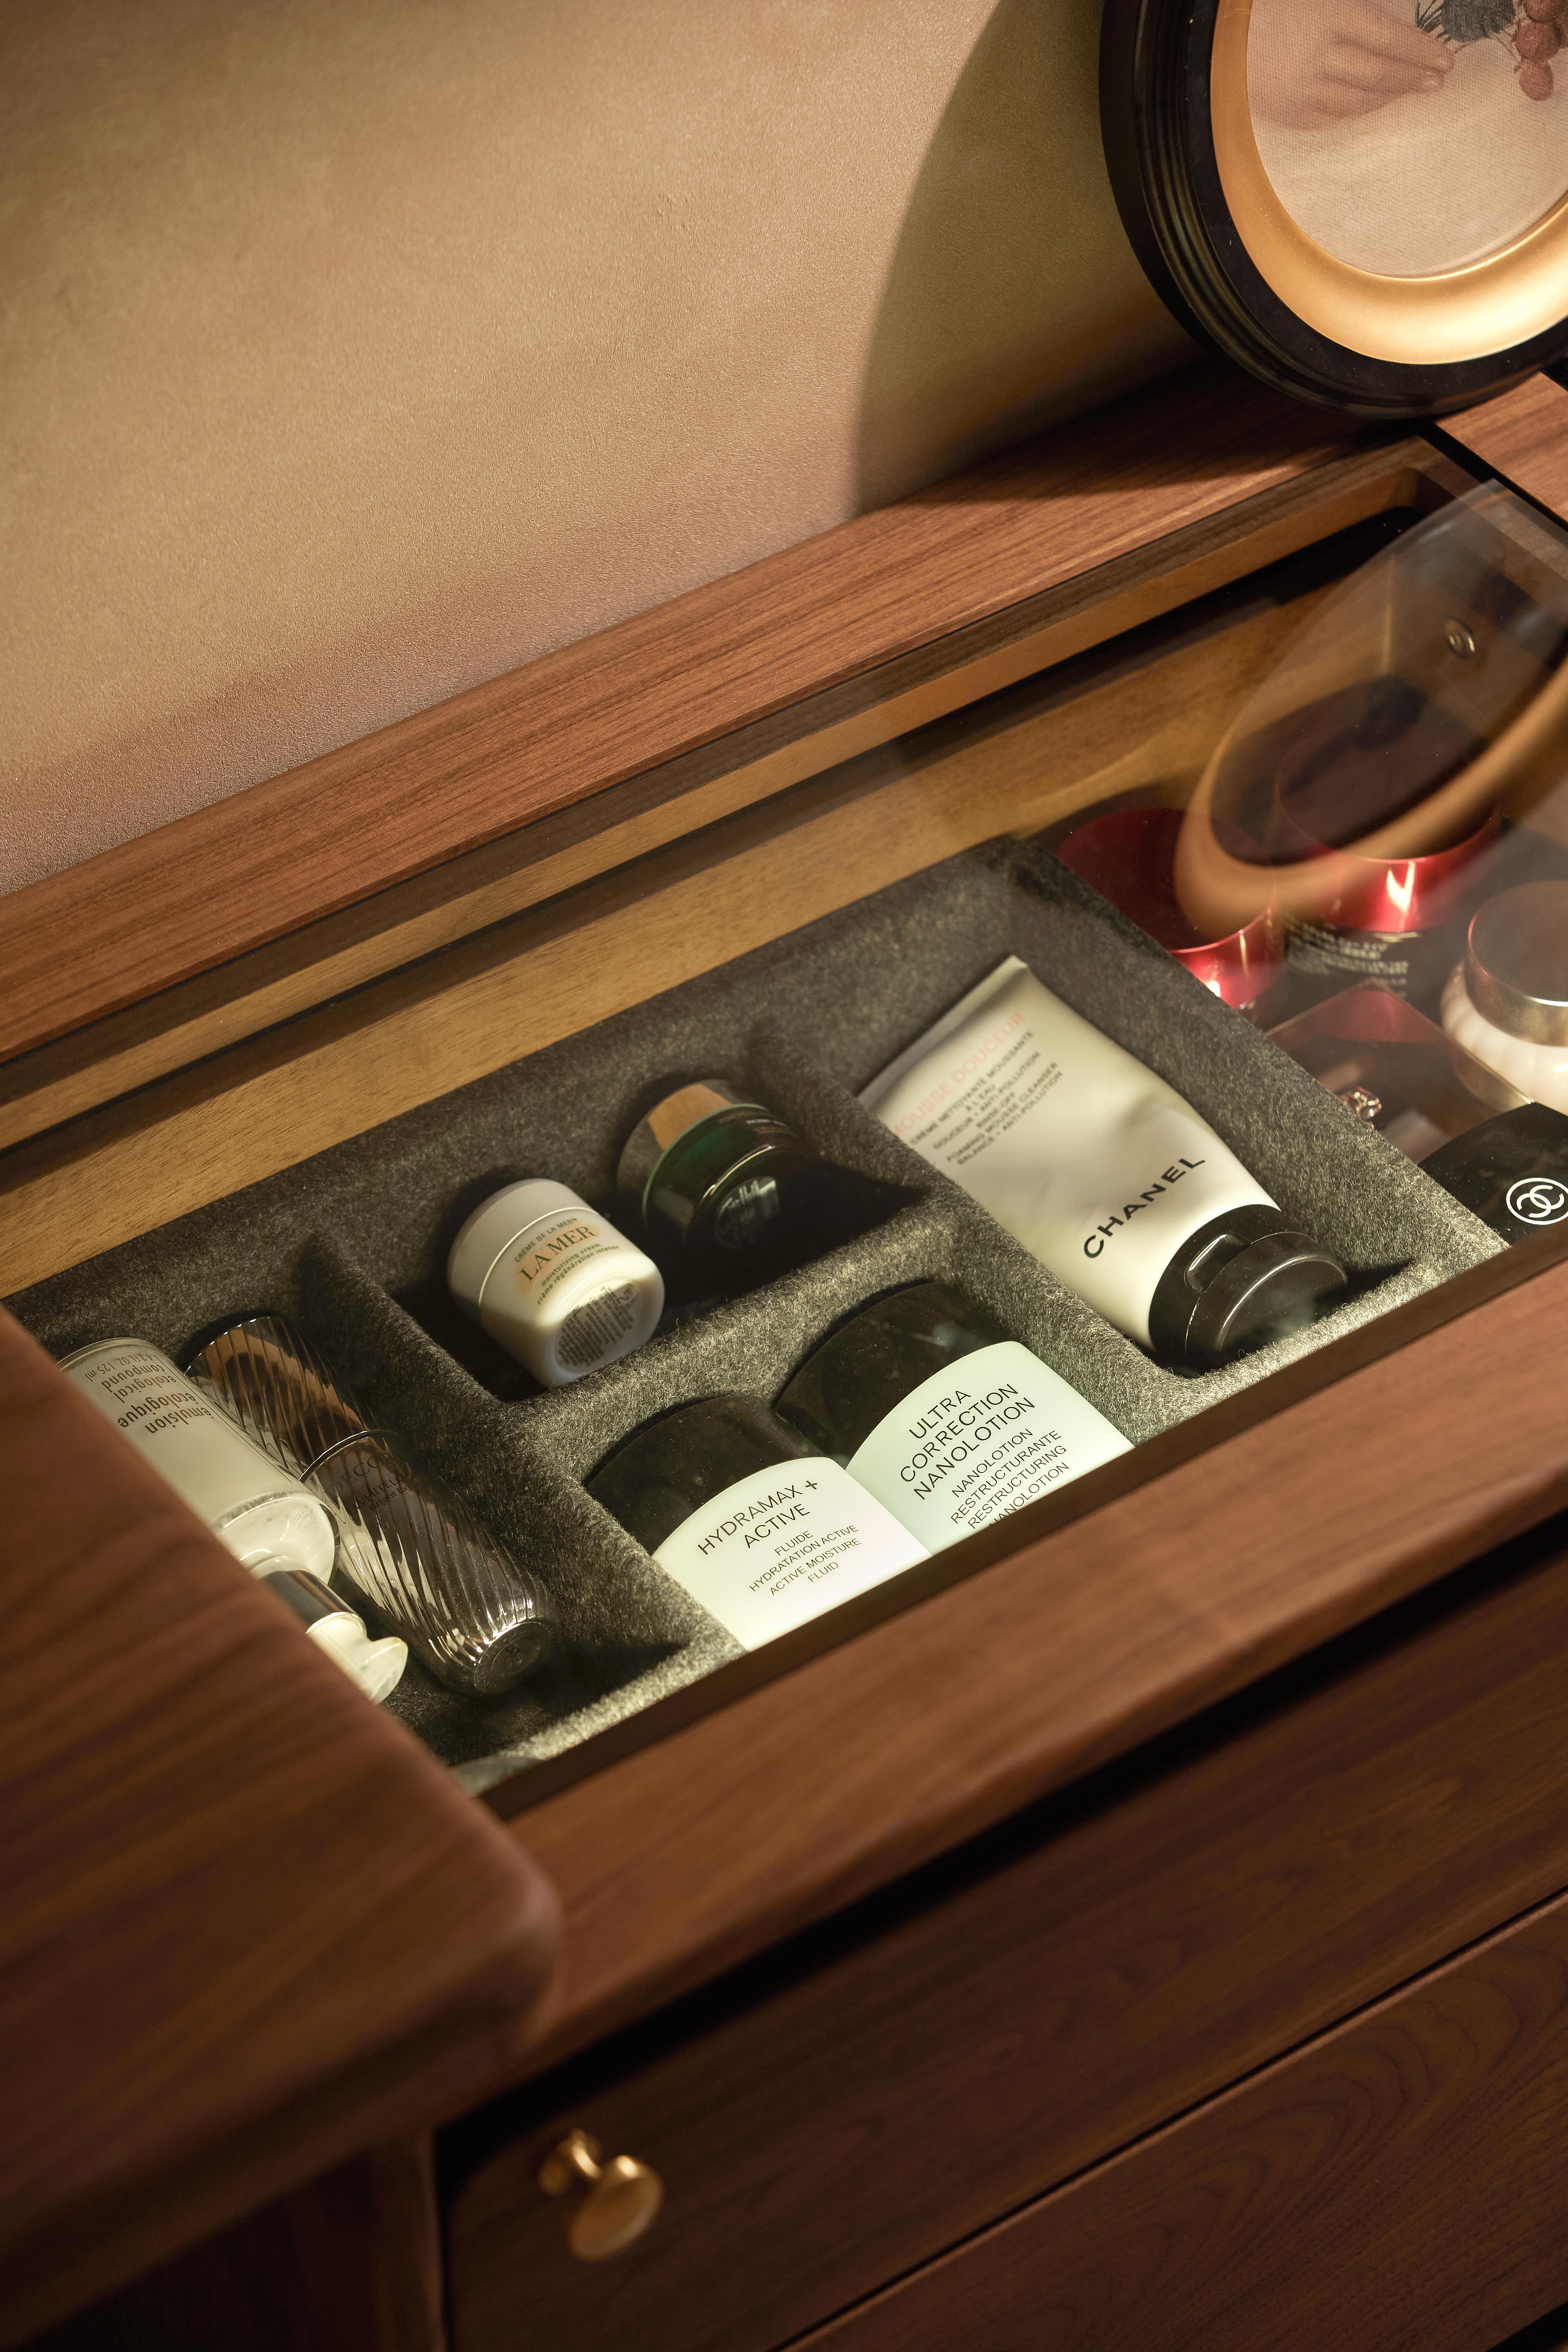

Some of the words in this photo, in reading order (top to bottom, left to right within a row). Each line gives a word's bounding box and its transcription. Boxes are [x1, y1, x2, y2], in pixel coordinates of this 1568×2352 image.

[1084, 1158, 1205, 1258] CHANEL
[519, 1255, 551, 1283] LA
[546, 1227, 596, 1255] MER
[536, 1233, 546, 1241] DE
[537, 1283, 553, 1305] crème
[554, 1252, 594, 1283] régénération
[596, 1246, 619, 1254] intense
[541, 1253, 580, 1287] moisturizing
[580, 1243, 601, 1254] cream
[85, 1370, 97, 1382] ml
[97, 1362, 116, 1374] 125
[101, 1365, 164, 1393] compound
[113, 1376, 176, 1403] ecological
[117, 1393, 198, 1427] écologique
[145, 1407, 214, 1433] émulsion
[900, 1384, 1018, 1482] CORRECTION
[909, 1390, 971, 1439] ULTRA
[913, 1397, 1035, 1500] NANOLOTION
[952, 1429, 1033, 1497] NANOLOTION
[950, 1430, 1061, 1524] RESTRUCTURANTE
[968, 1445, 1067, 1529] RESTRUCTURING
[989, 1462, 1069, 1525] ANOLOTION
[698, 1485, 803, 1555] HYDRAMAX
[805, 1481, 818, 1489] +
[744, 1504, 810, 1548] ACTIVE
[775, 1531, 814, 1556] FLUIDE
[750, 1541, 821, 1592] HYDRATATION
[822, 1525, 859, 1544] ACTIVE
[770, 1566, 806, 1595] ACTIVE
[806, 1538, 861, 1568] MOISTURE
[808, 1561, 838, 1582] FLUID
